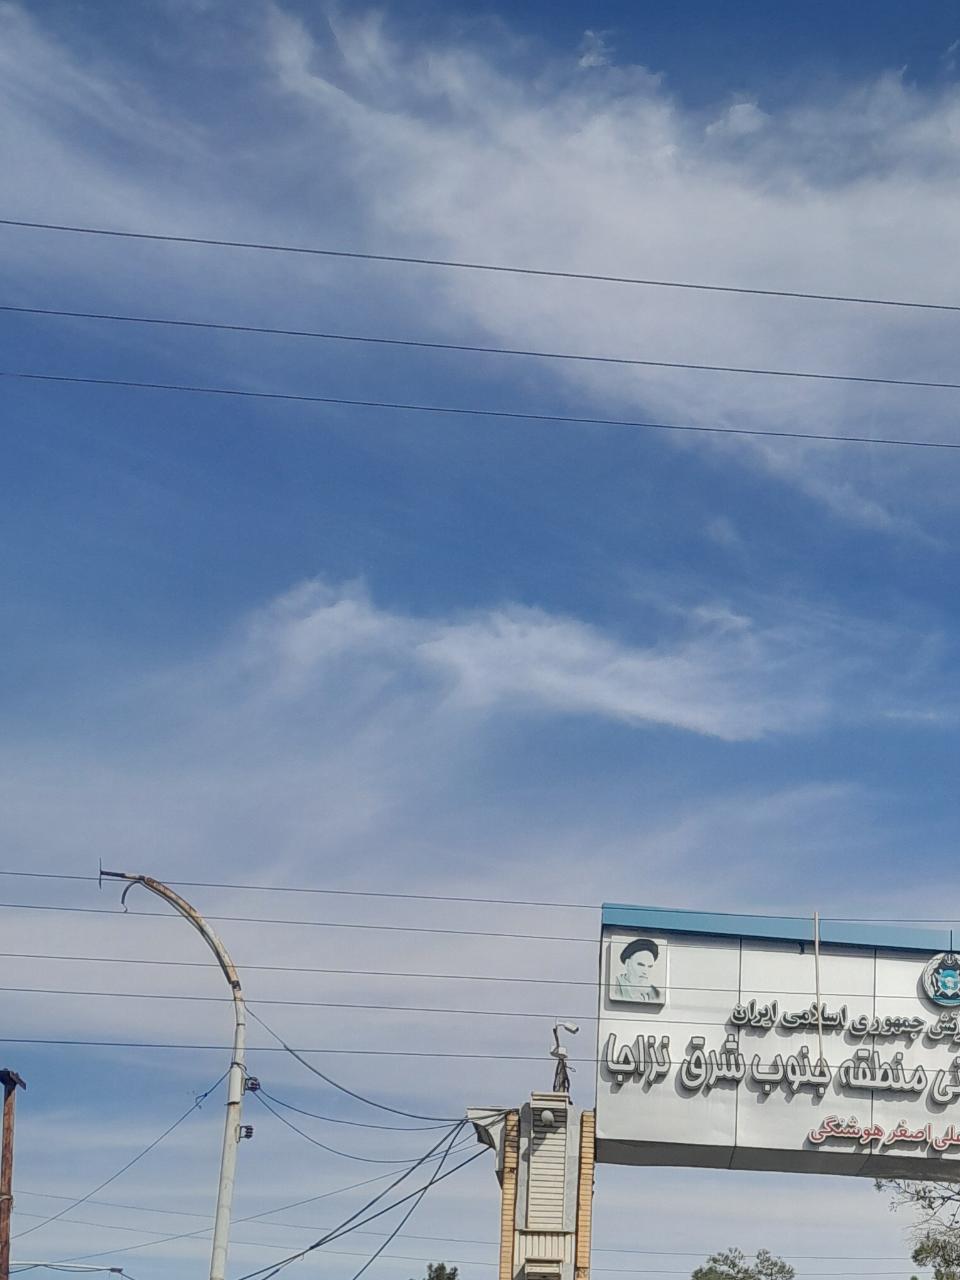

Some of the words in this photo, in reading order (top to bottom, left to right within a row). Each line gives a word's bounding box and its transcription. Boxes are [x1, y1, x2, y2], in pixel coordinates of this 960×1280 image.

[730, 999, 779, 1027] ایران
[782, 1001, 848, 1027] اسلامی
[850, 1013, 927, 1037] جمهوری
[606, 1032, 671, 1083] نزاجا
[681, 1033, 747, 1089] شرق
[751, 1045, 832, 1095] جنوب
[839, 1048, 928, 1094] منطقه
[809, 1115, 886, 1145] هوشنگی
[886, 1119, 933, 1146] اصغر
